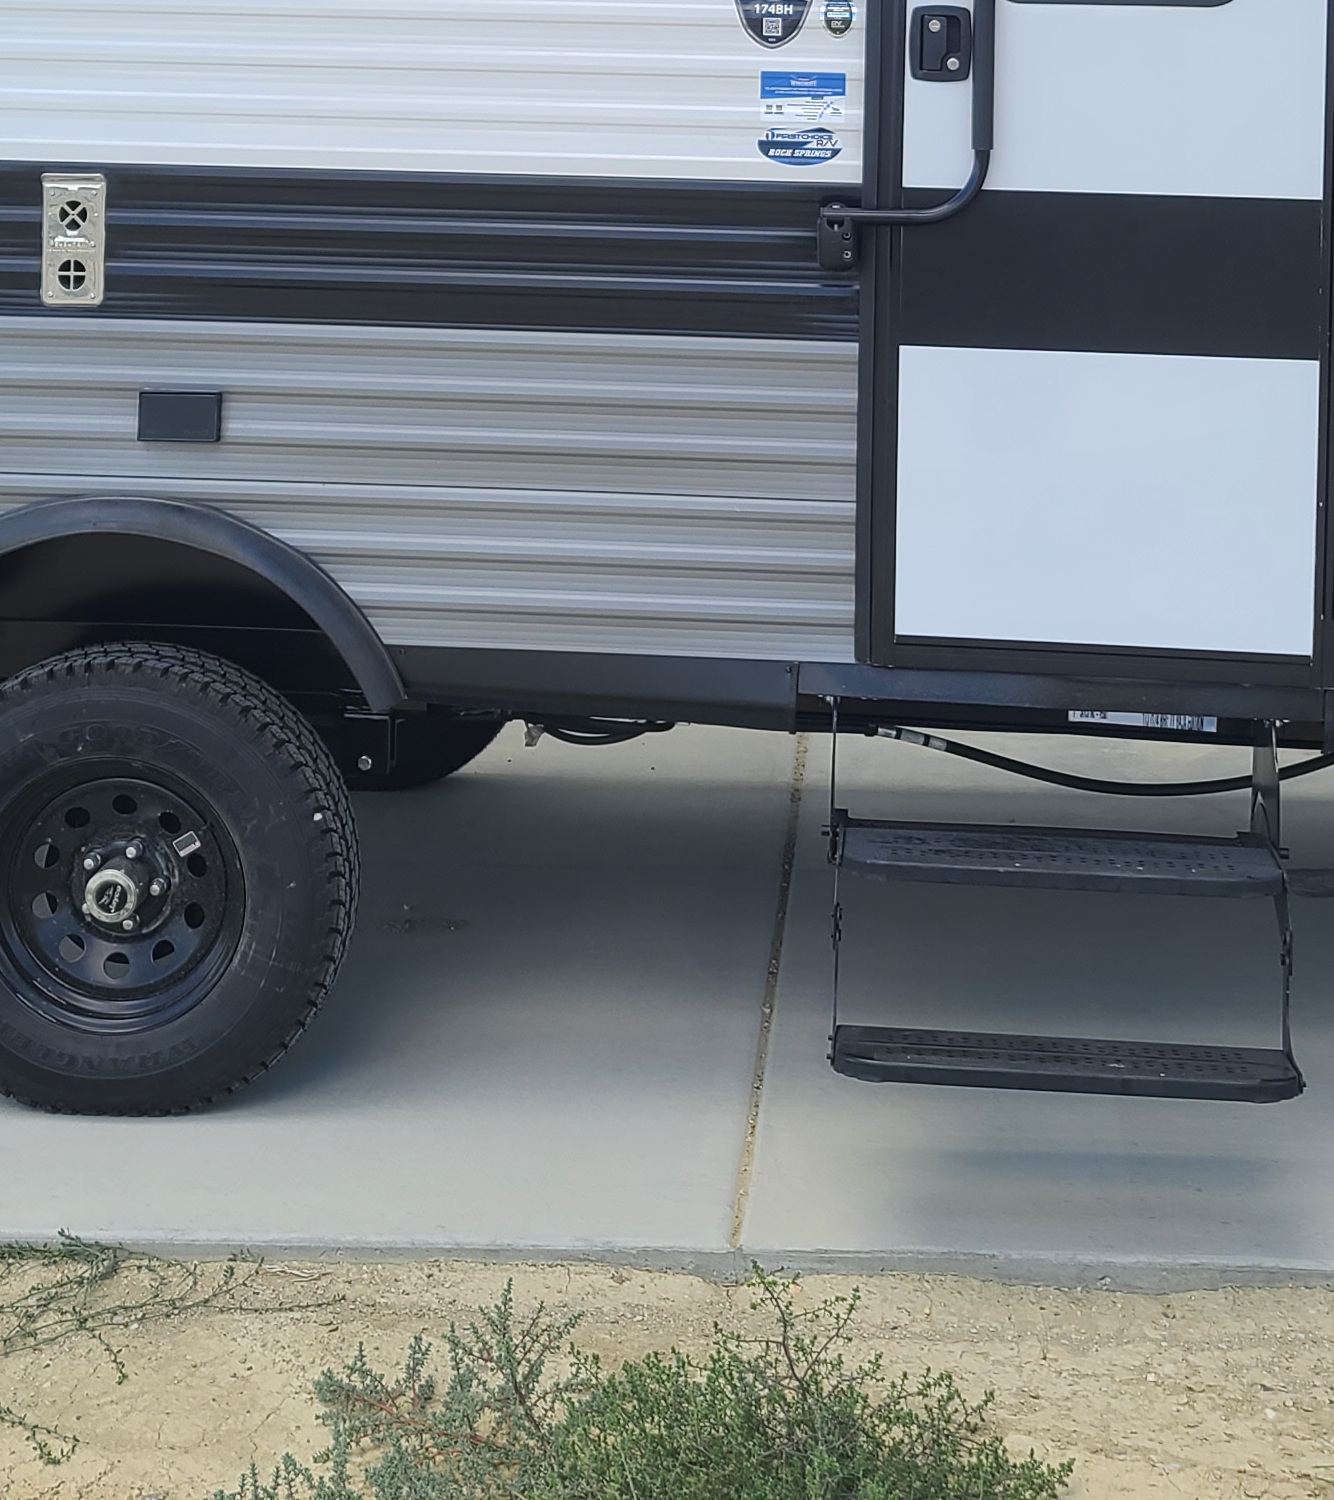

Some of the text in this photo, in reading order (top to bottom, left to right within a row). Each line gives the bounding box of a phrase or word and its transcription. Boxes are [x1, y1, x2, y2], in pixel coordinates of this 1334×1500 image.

[754, 3, 793, 15] 174BH
[768, 148, 832, 158] ROCK SPRINGS
